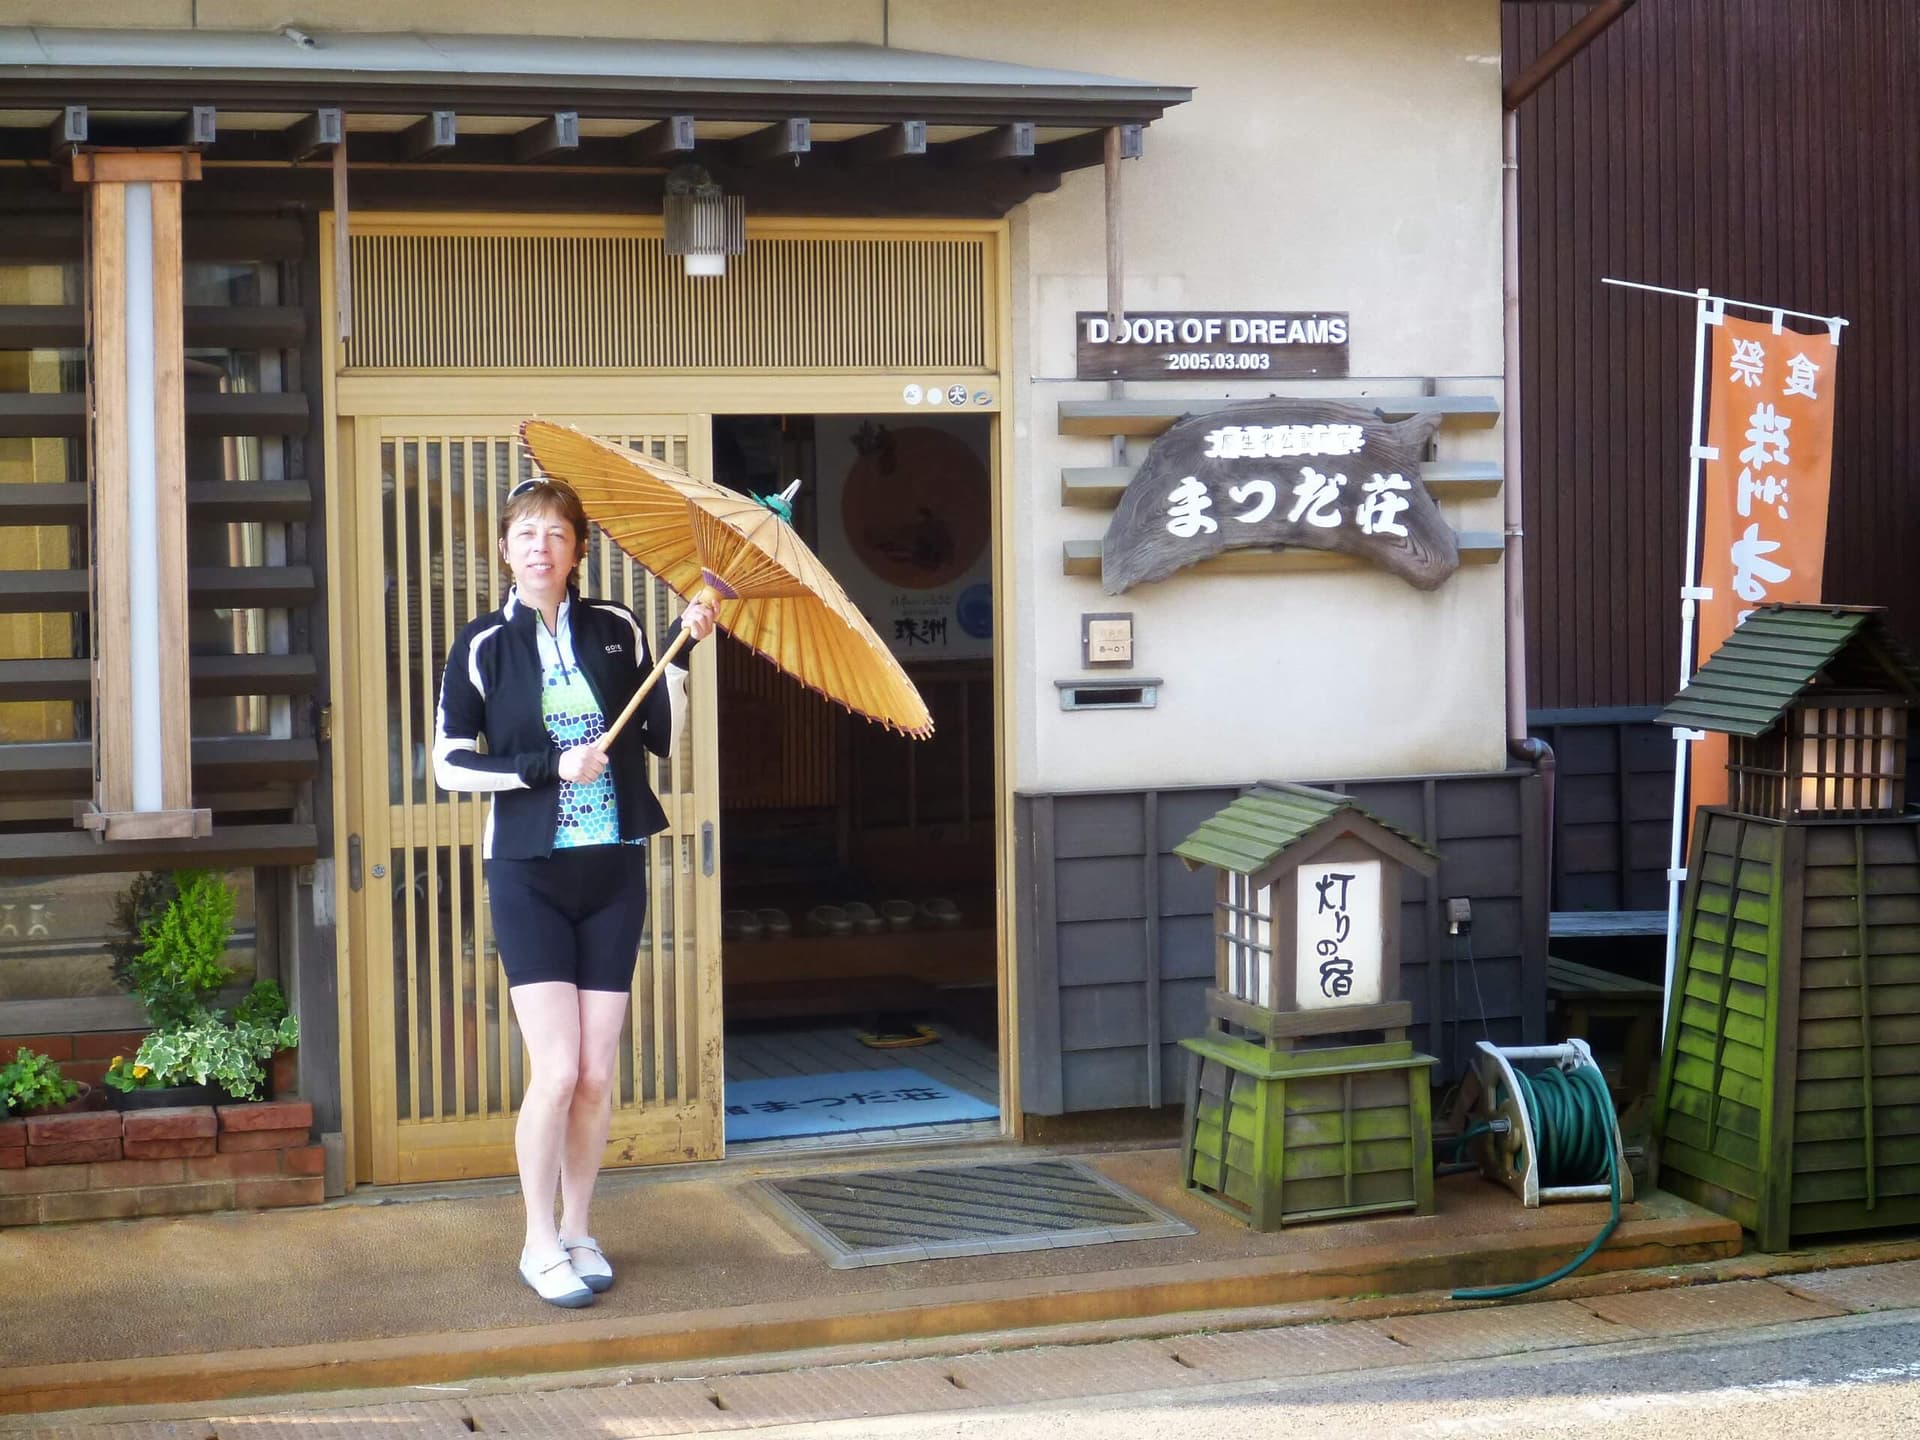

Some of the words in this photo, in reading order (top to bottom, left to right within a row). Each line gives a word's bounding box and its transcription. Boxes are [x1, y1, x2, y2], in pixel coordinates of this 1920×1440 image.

[1181, 319, 1221, 344] OF
[1229, 319, 1347, 344] DREAMS
[1168, 353, 1270, 370] 2005.03.003
[1166, 466, 1412, 538] まつだ荘
[893, 616, 947, 646] 珠洲
[1315, 873, 1356, 998] 灯りの宿
